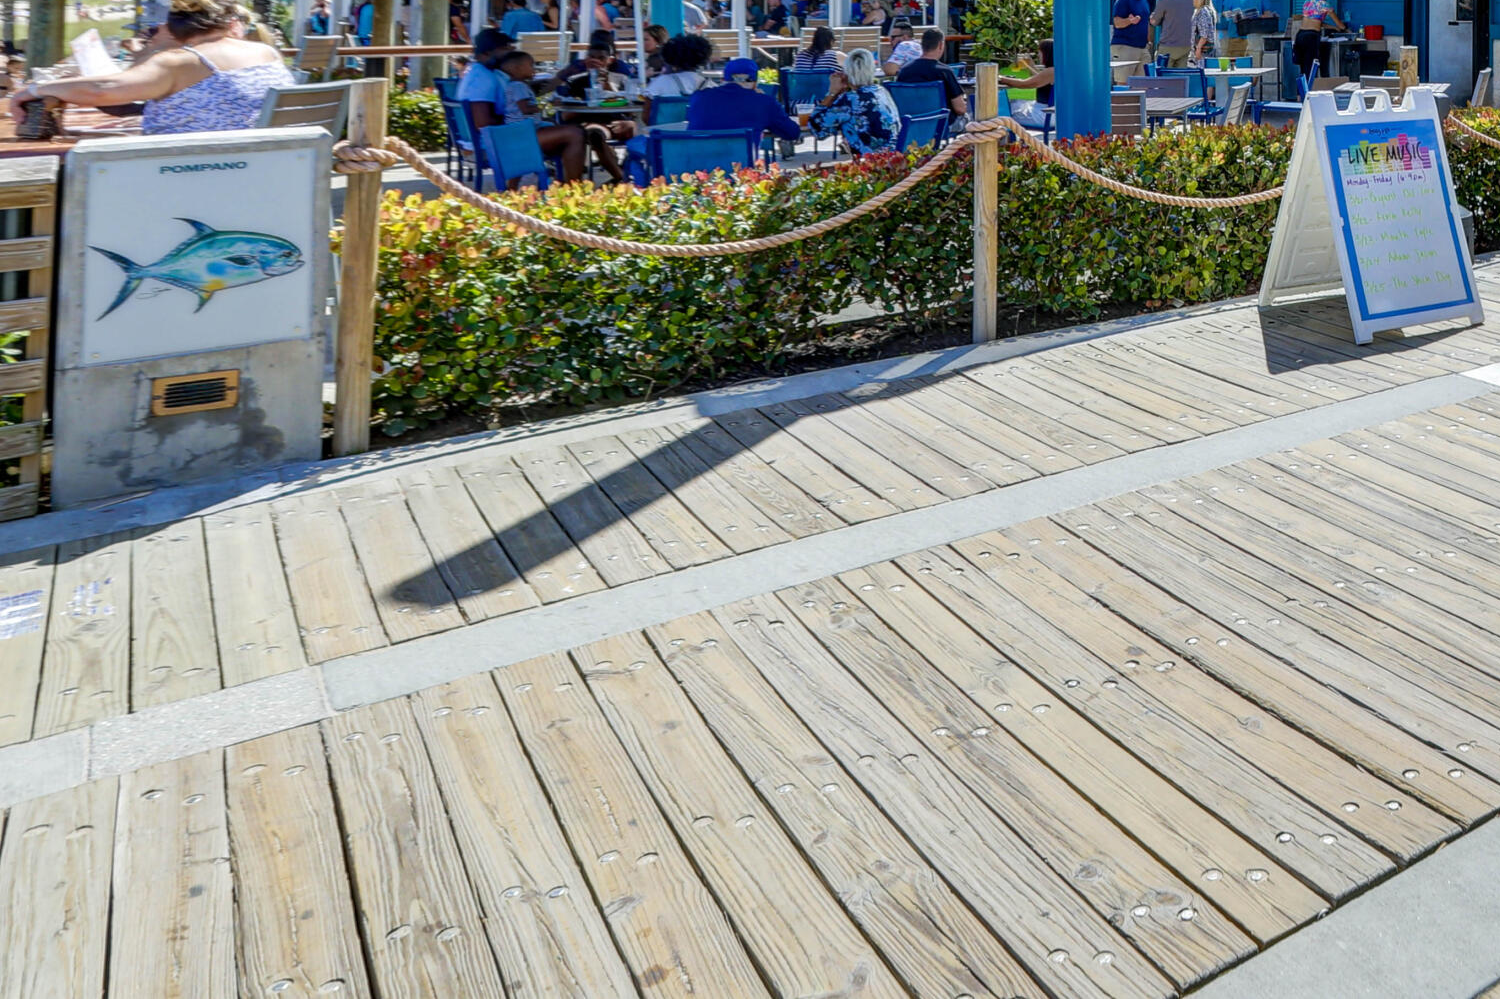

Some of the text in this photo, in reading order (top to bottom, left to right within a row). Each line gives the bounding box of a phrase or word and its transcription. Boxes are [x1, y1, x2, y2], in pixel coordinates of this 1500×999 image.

[1348, 141, 1425, 164] LIVE MUSIC
[159, 160, 248, 174] POMPANO
